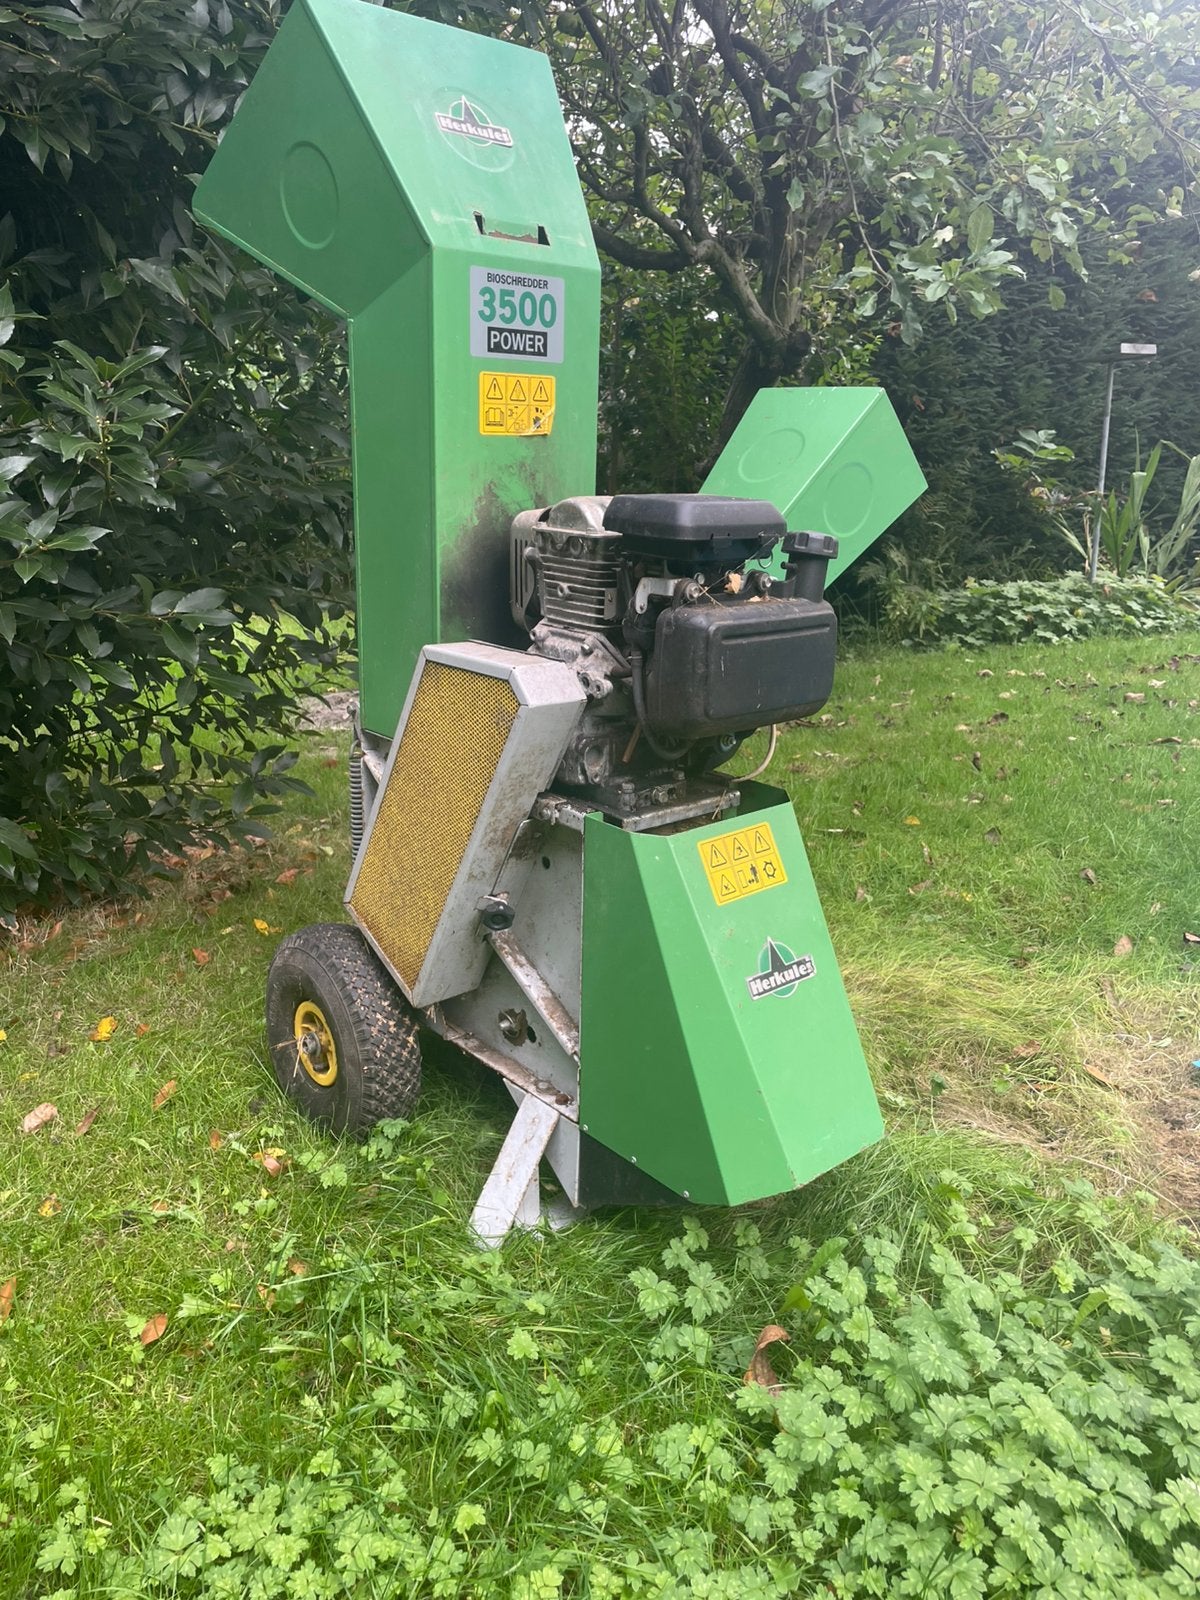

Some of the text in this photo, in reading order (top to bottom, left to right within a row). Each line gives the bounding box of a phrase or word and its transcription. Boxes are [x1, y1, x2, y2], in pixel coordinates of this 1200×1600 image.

[486, 272, 549, 290] BIOSCHREDDER
[478, 286, 557, 329] 3500
[490, 330, 545, 353] POWER
[748, 957, 816, 996] Herkules
